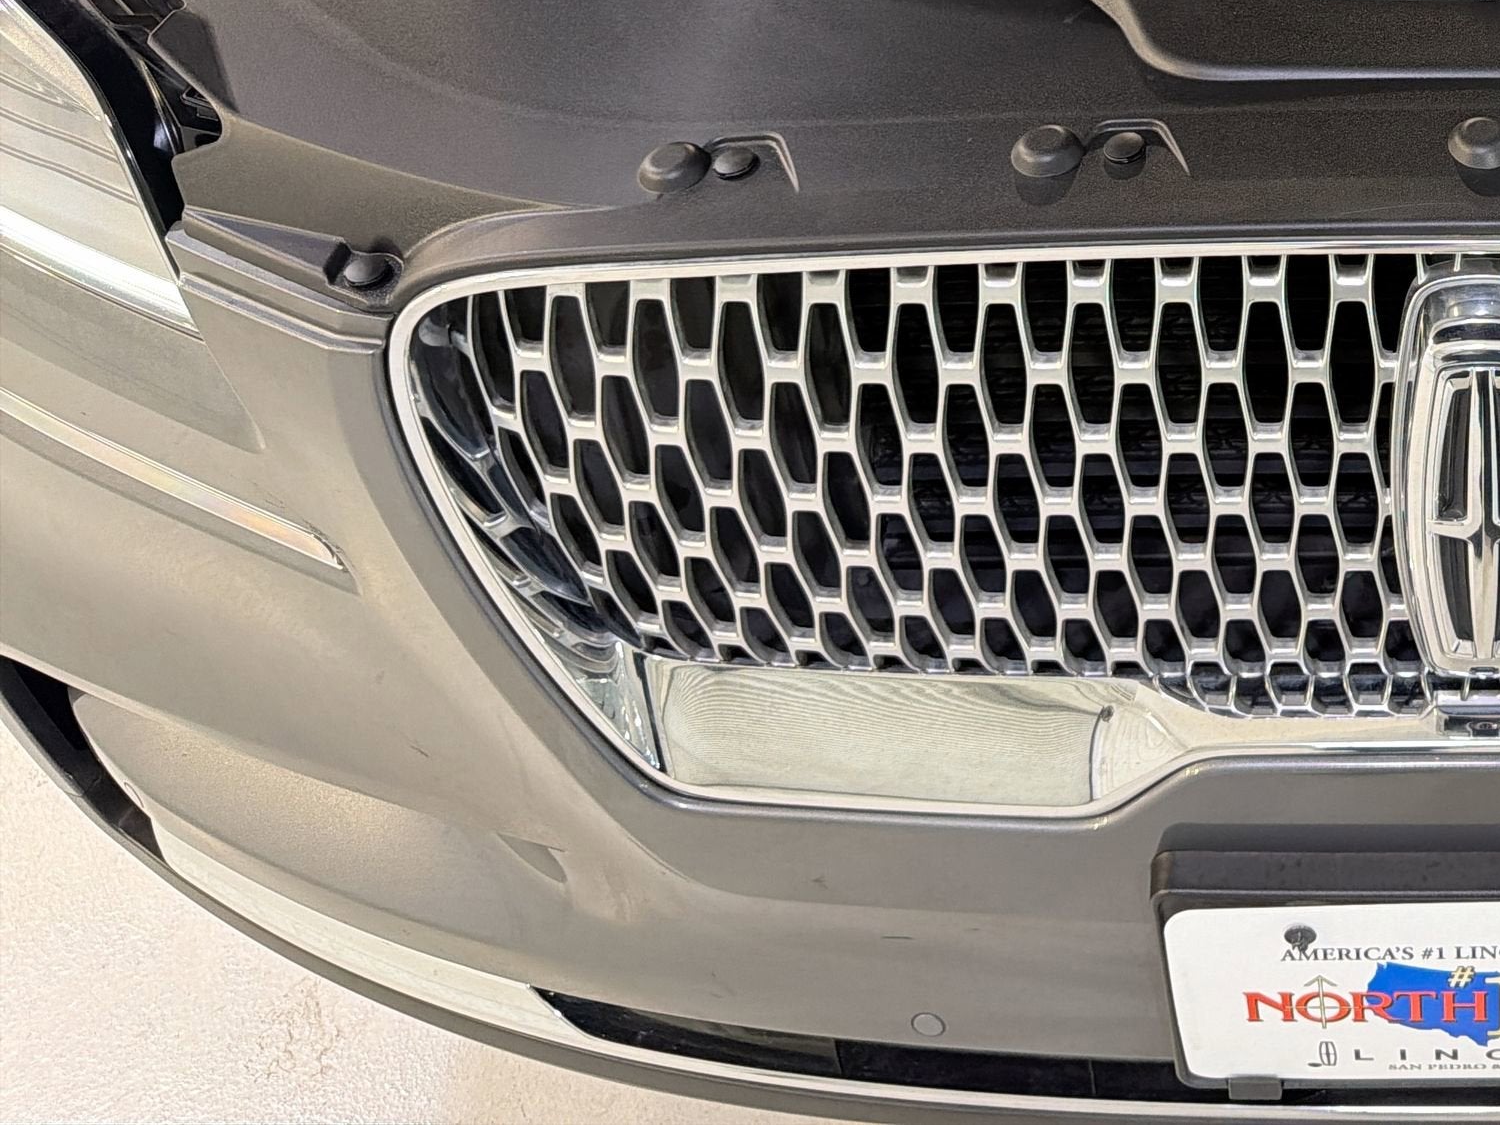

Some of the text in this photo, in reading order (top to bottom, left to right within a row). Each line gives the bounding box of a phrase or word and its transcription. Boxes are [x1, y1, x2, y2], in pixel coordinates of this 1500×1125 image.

[1421, 945, 1446, 960] #1
[1243, 990, 1489, 1024] NORTH
[1388, 1062, 1422, 1071] SAN
[1427, 1062, 1486, 1071] PEDRO
